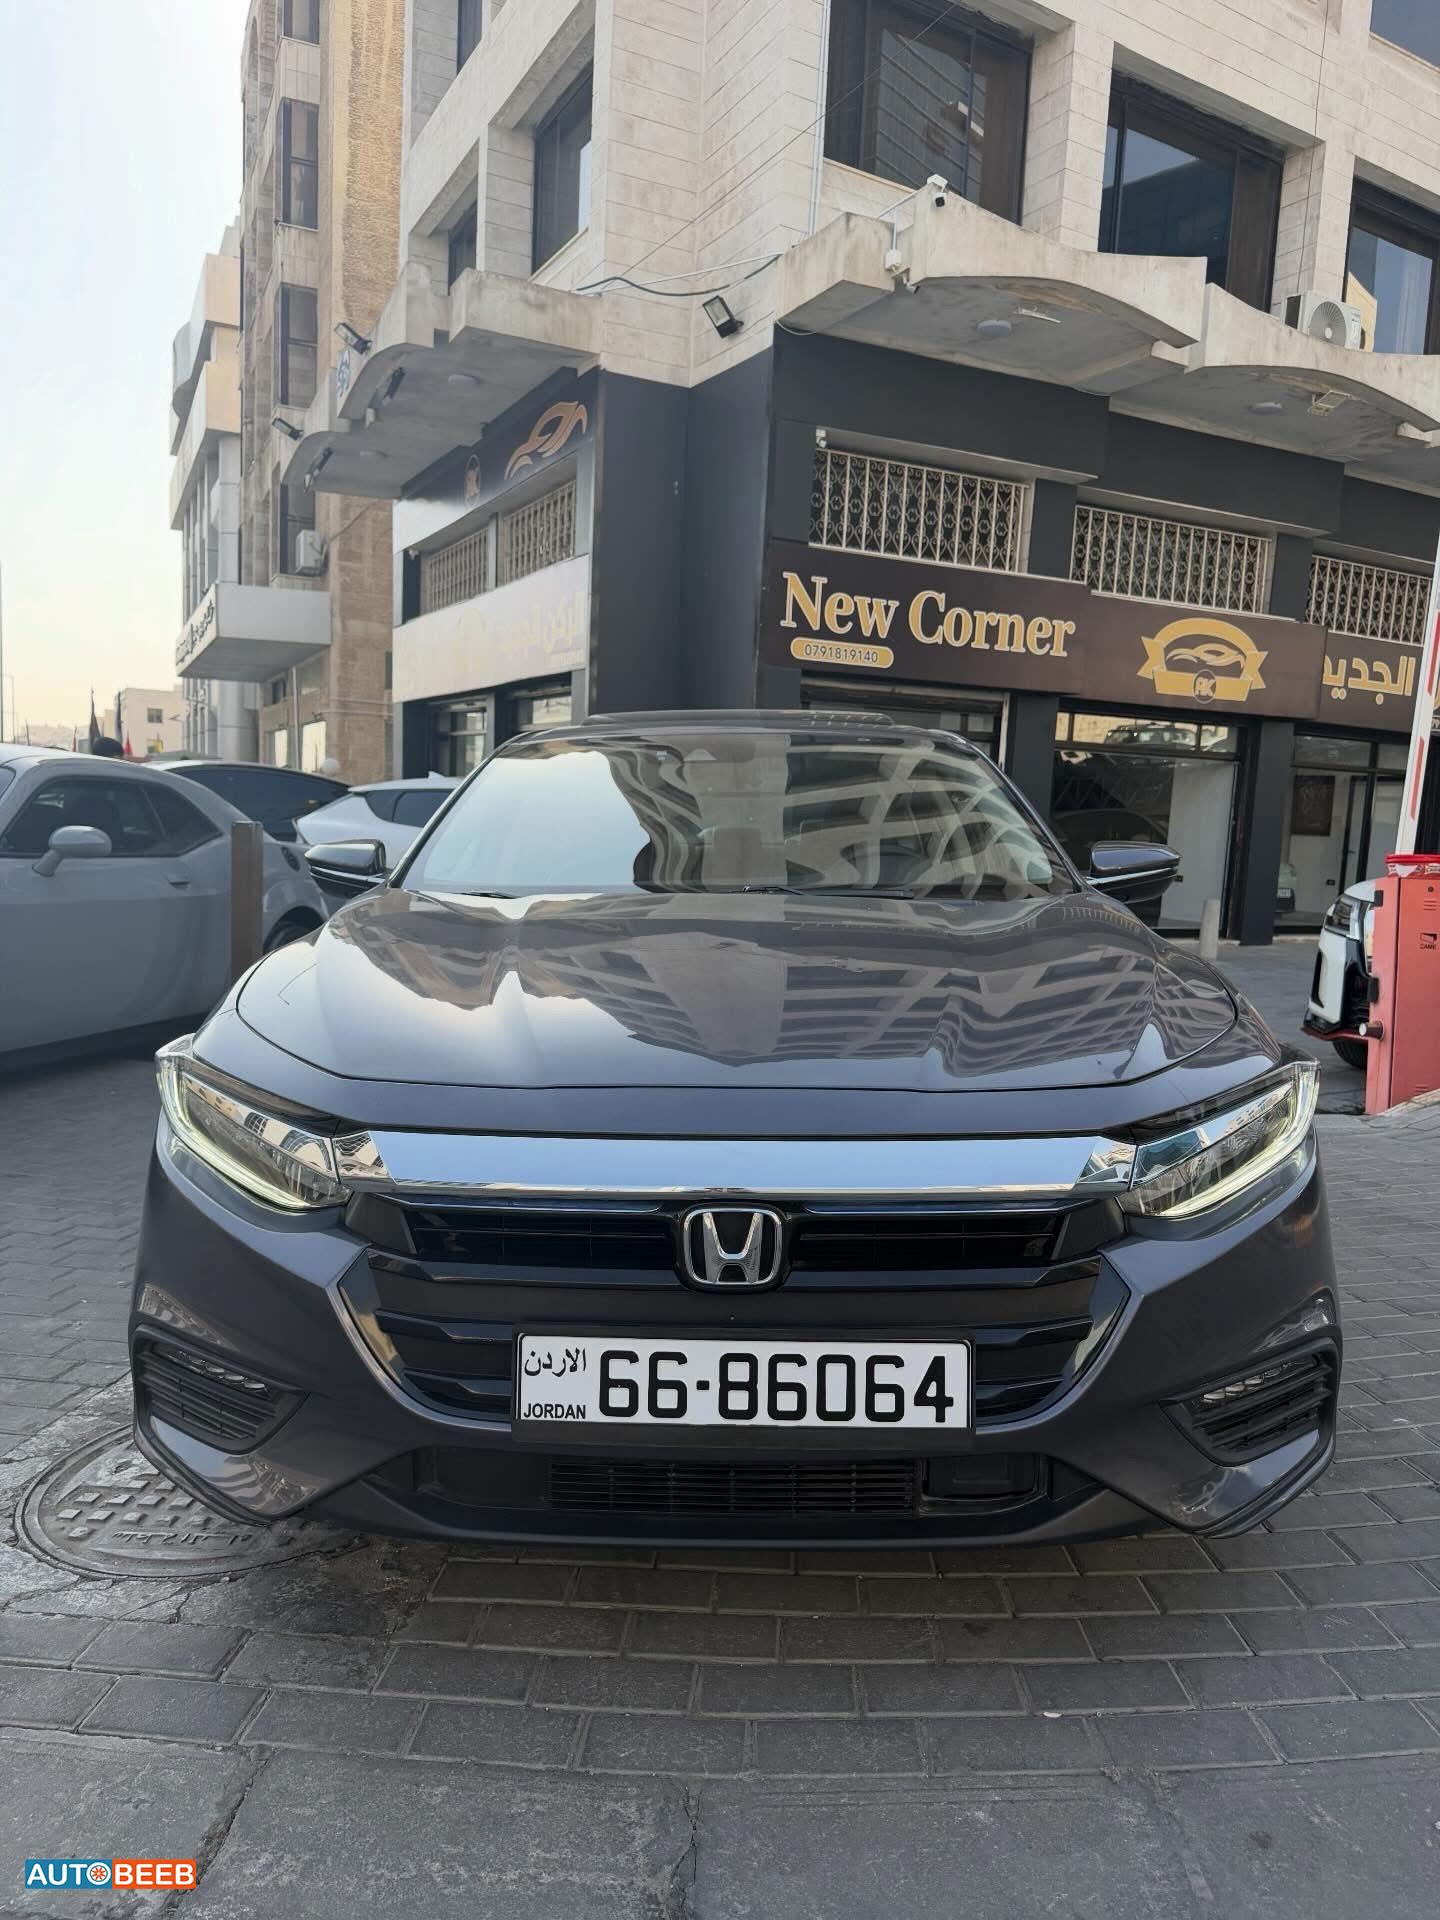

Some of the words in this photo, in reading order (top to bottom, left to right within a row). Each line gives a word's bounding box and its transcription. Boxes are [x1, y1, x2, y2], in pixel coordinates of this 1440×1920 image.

[780, 571, 899, 639] New
[908, 590, 1076, 658] Corner
[803, 643, 879, 664] 0791819140
[523, 1346, 587, 1379] الاردن
[598, 1349, 955, 1424] 66-86064
[523, 1402, 587, 1420] JORDAN
